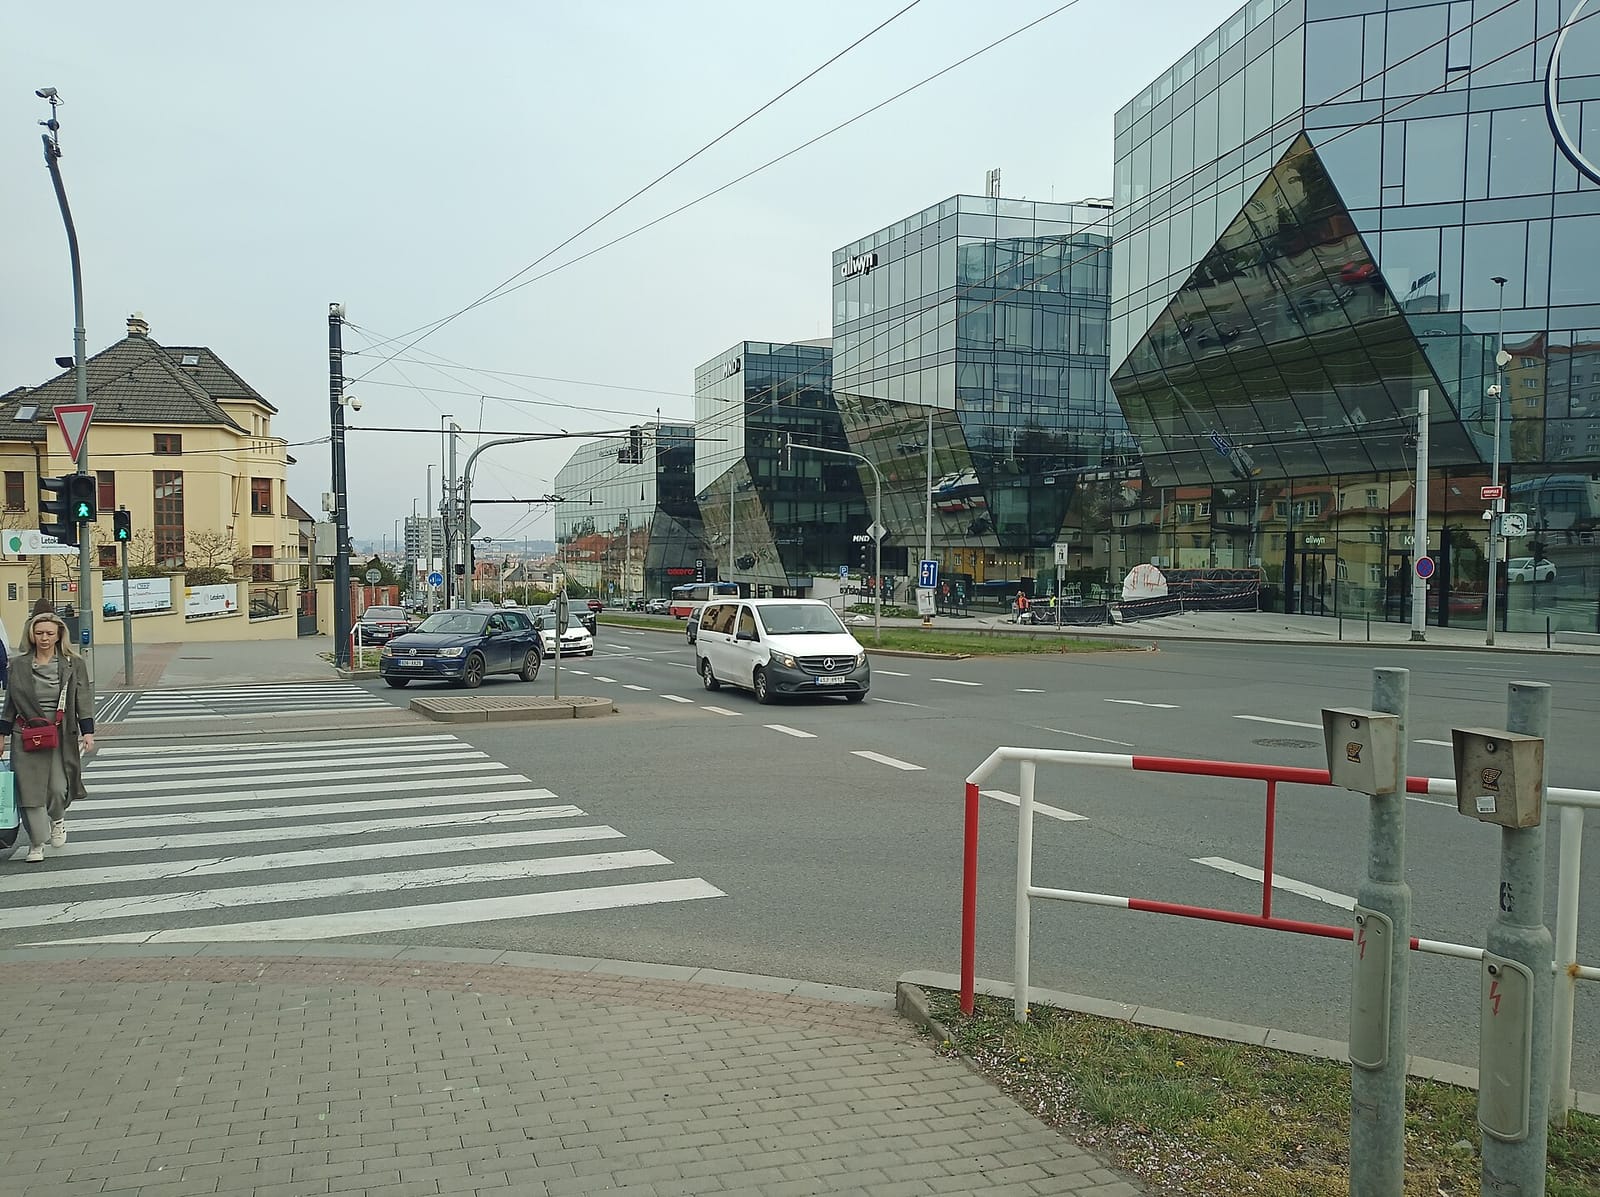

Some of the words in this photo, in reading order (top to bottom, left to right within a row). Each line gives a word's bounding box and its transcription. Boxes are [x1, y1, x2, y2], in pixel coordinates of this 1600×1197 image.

[840, 253, 875, 276] allwyn
[1305, 535, 1325, 546] allwyn
[1404, 535, 1430, 545] KKG
